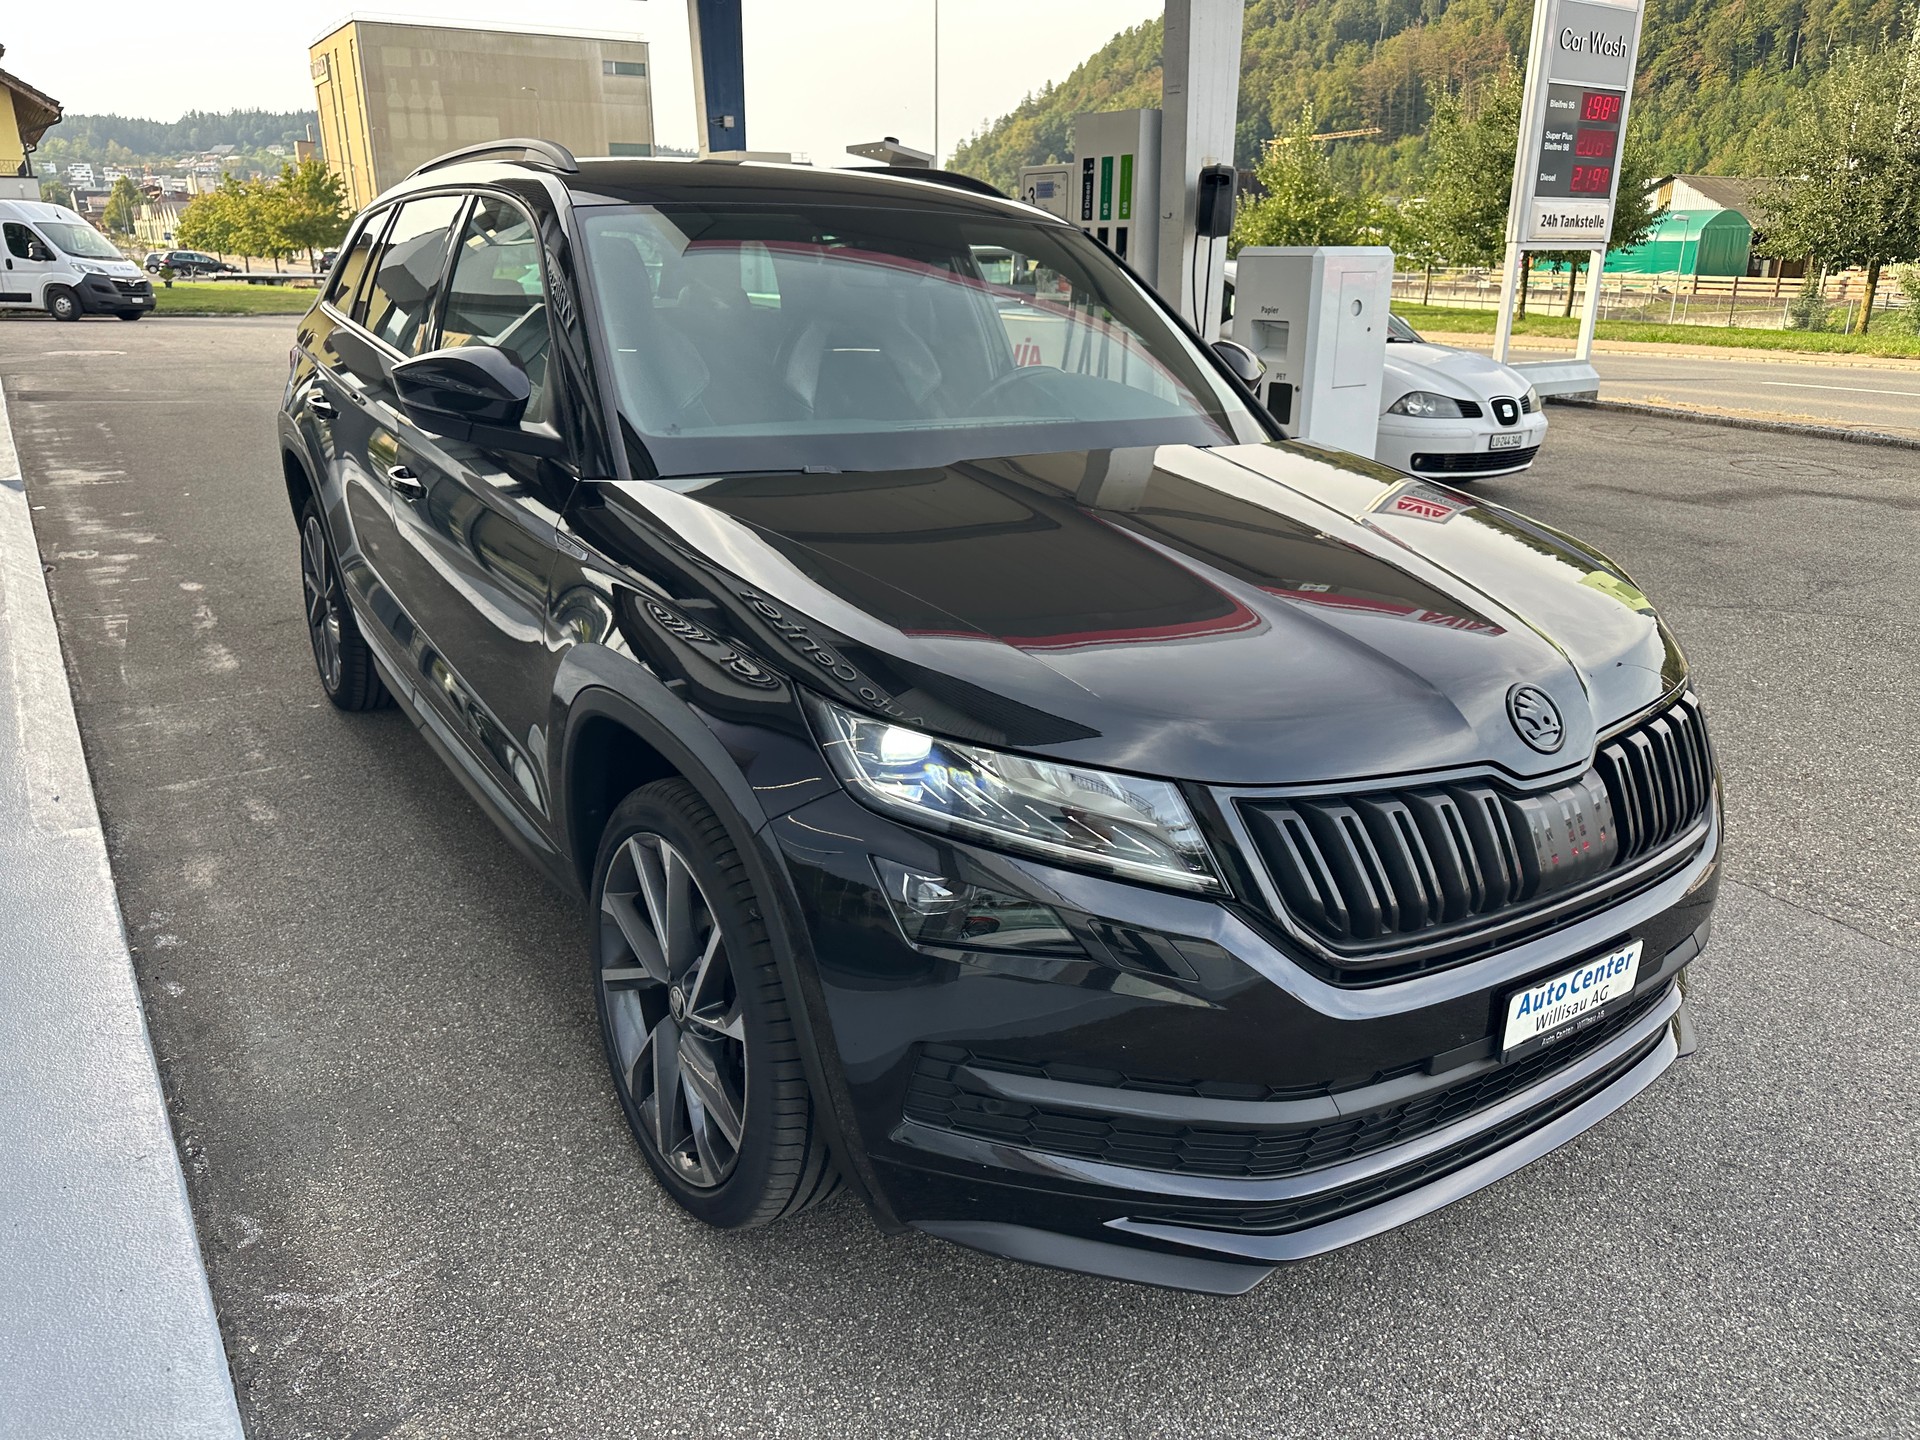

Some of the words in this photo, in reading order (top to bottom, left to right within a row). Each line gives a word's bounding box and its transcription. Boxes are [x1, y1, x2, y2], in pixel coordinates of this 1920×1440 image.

[1560, 27, 1587, 51] Car
[1590, 31, 1627, 57] Wash
[1550, 99, 1568, 109] Bleifrei
[1567, 101, 1575, 110] 95
[1545, 131, 1561, 141] Super
[1562, 131, 1573, 141] Plus
[1544, 142, 1562, 151] Bleifrei
[1563, 143, 1569, 151] 98
[1540, 173, 1556, 182] Diesel
[1028, 186, 1036, 204] 3
[1541, 214, 1558, 227] 24h
[1560, 214, 1605, 228] Tankstelle
[1261, 306, 1279, 316] Papier
[1516, 981, 1567, 1019] Auto
[1570, 952, 1634, 994] Center
[1535, 999, 1587, 1031] Willisau
[1590, 985, 1609, 1006] AG
